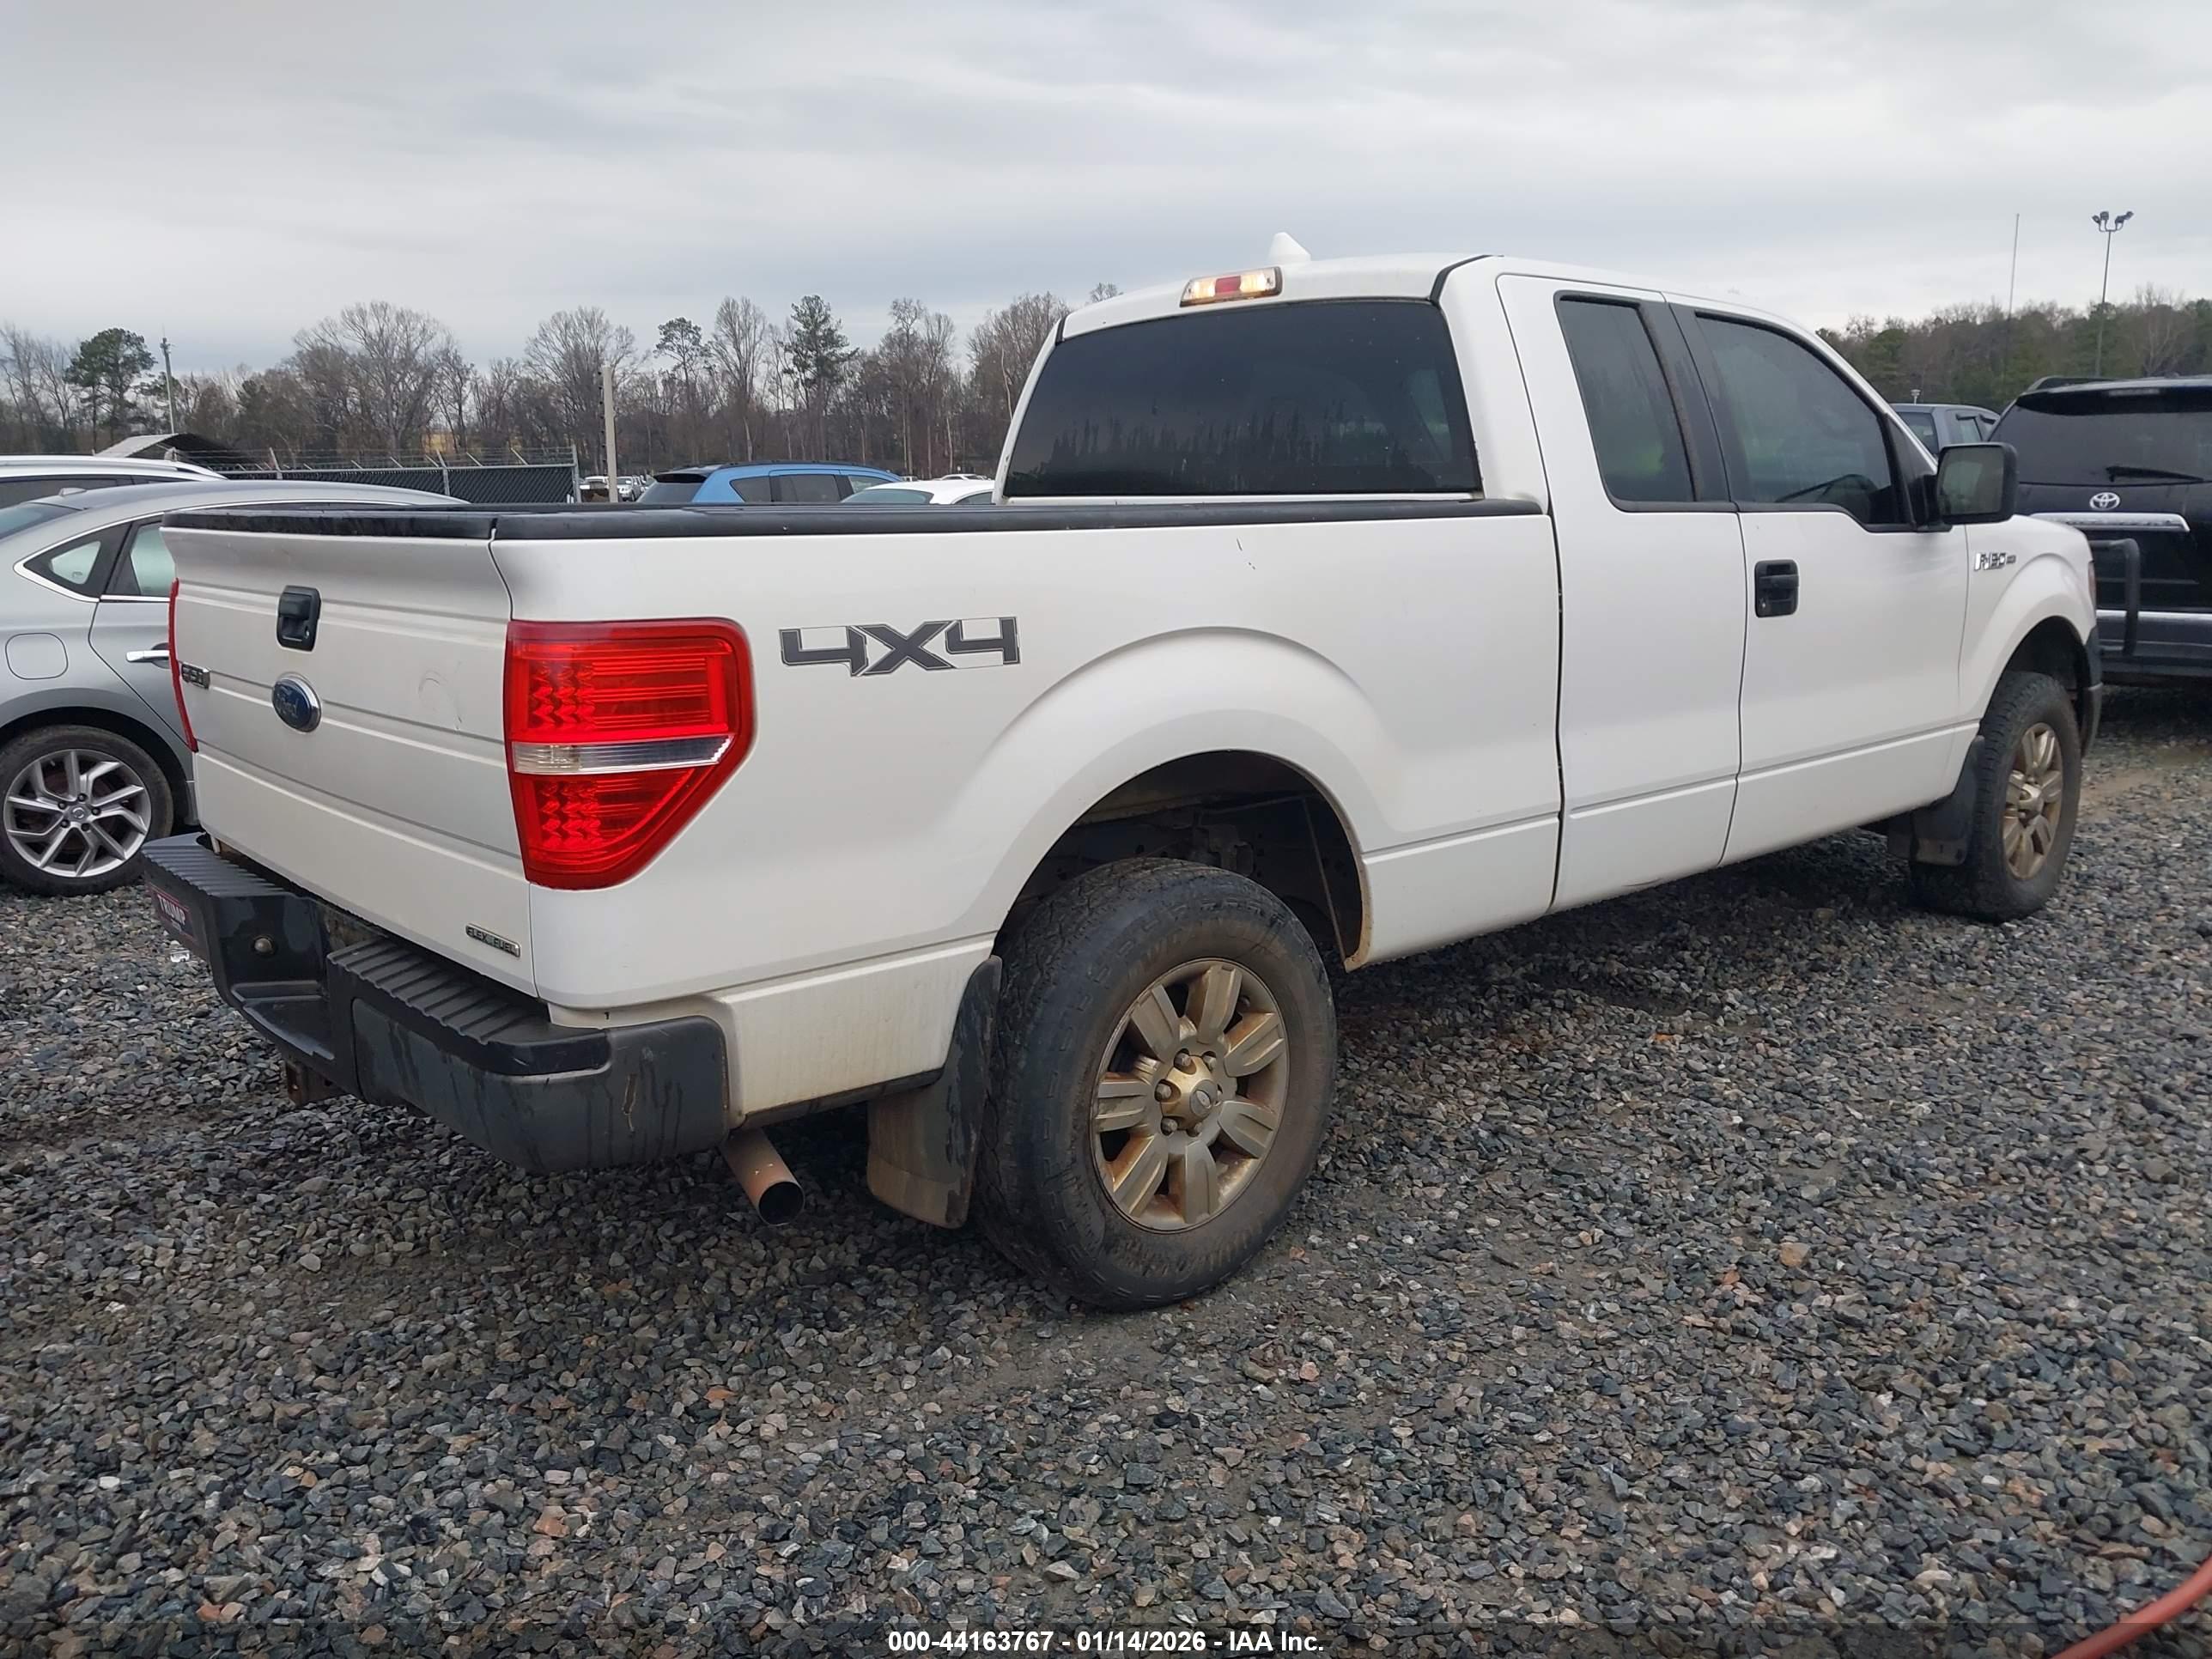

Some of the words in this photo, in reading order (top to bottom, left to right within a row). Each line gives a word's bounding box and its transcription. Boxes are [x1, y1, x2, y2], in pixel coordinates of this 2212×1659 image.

[157, 894, 186, 926] TRUMP
[467, 927, 489, 945] FLEX
[494, 937, 517, 956] FUEL
